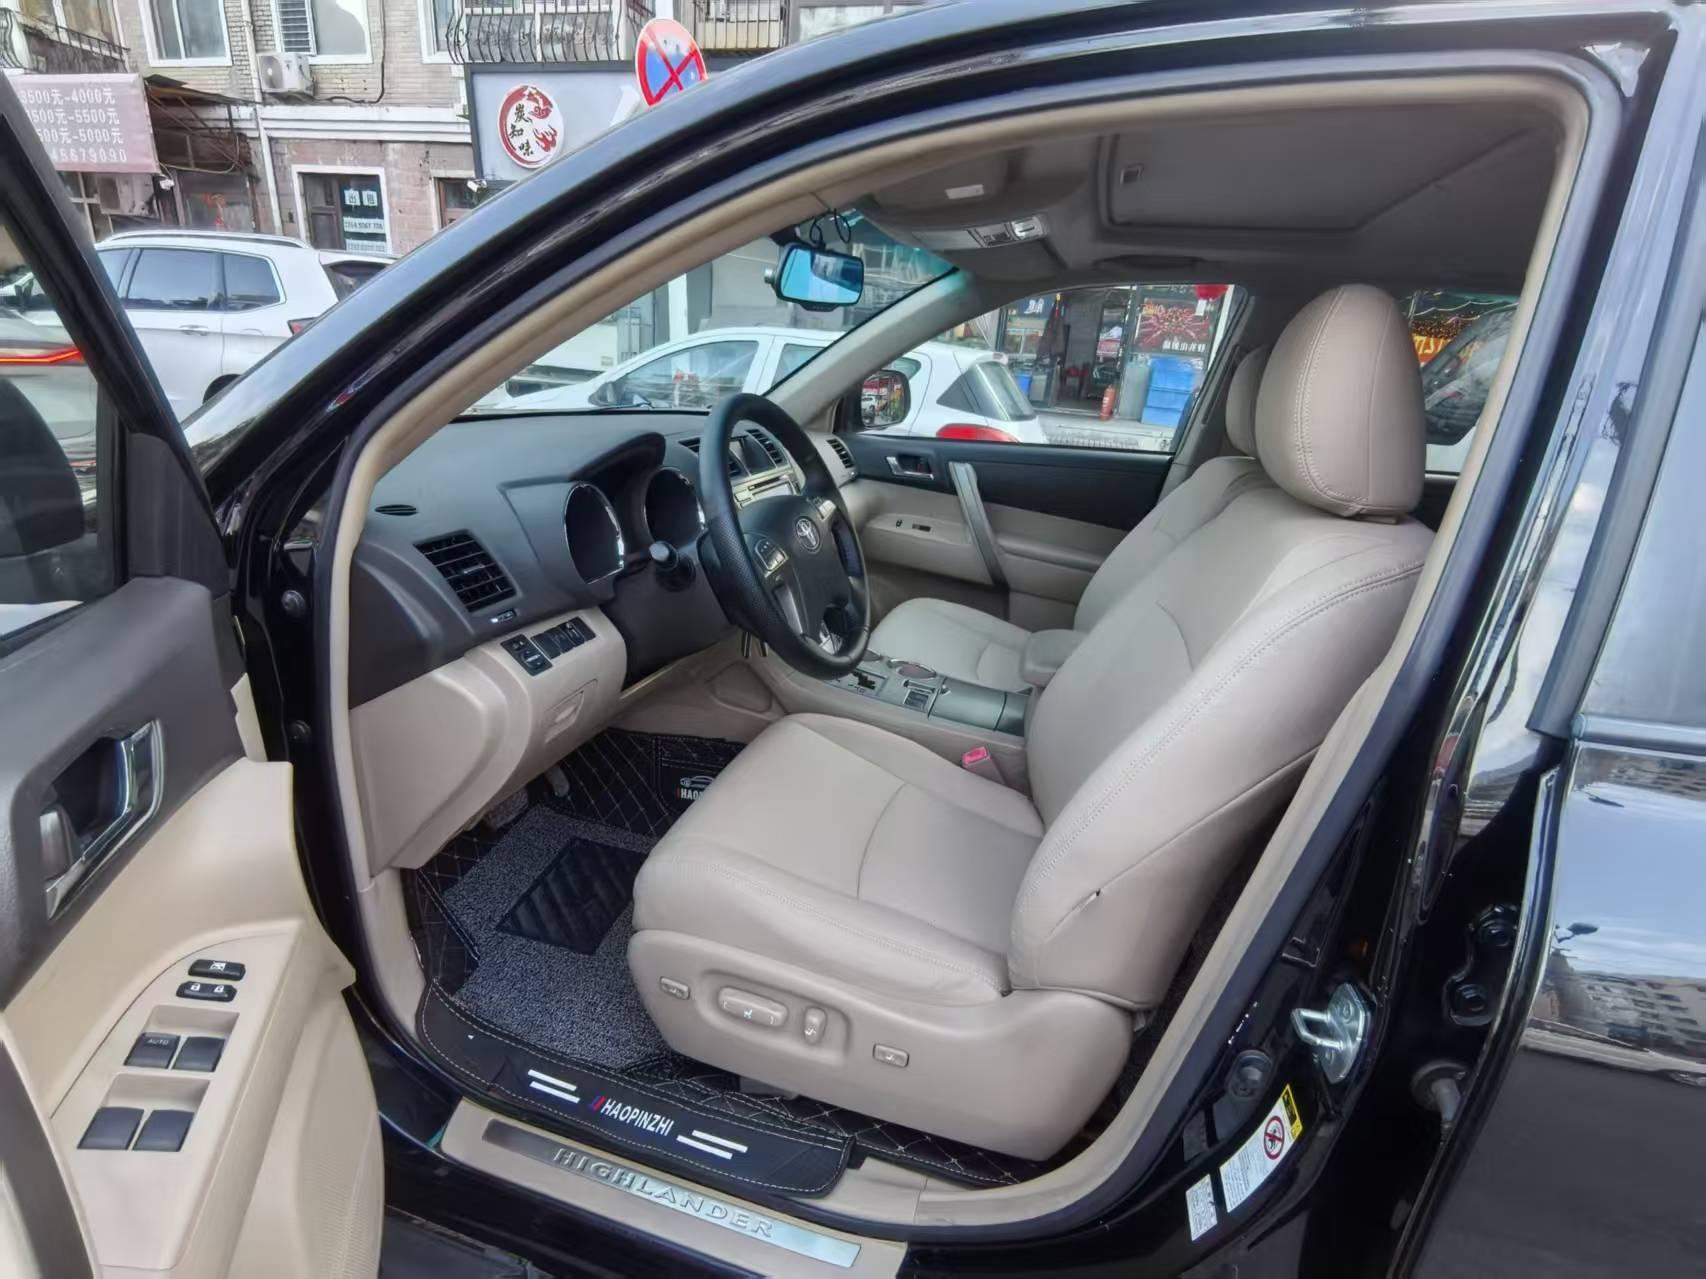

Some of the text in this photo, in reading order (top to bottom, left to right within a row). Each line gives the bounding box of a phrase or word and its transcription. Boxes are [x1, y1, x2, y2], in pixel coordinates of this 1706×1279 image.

[147, 1038, 169, 1046] AUTO
[600, 1098, 674, 1137] HAOPINZHI
[553, 1148, 774, 1239] HIGHLANDER
